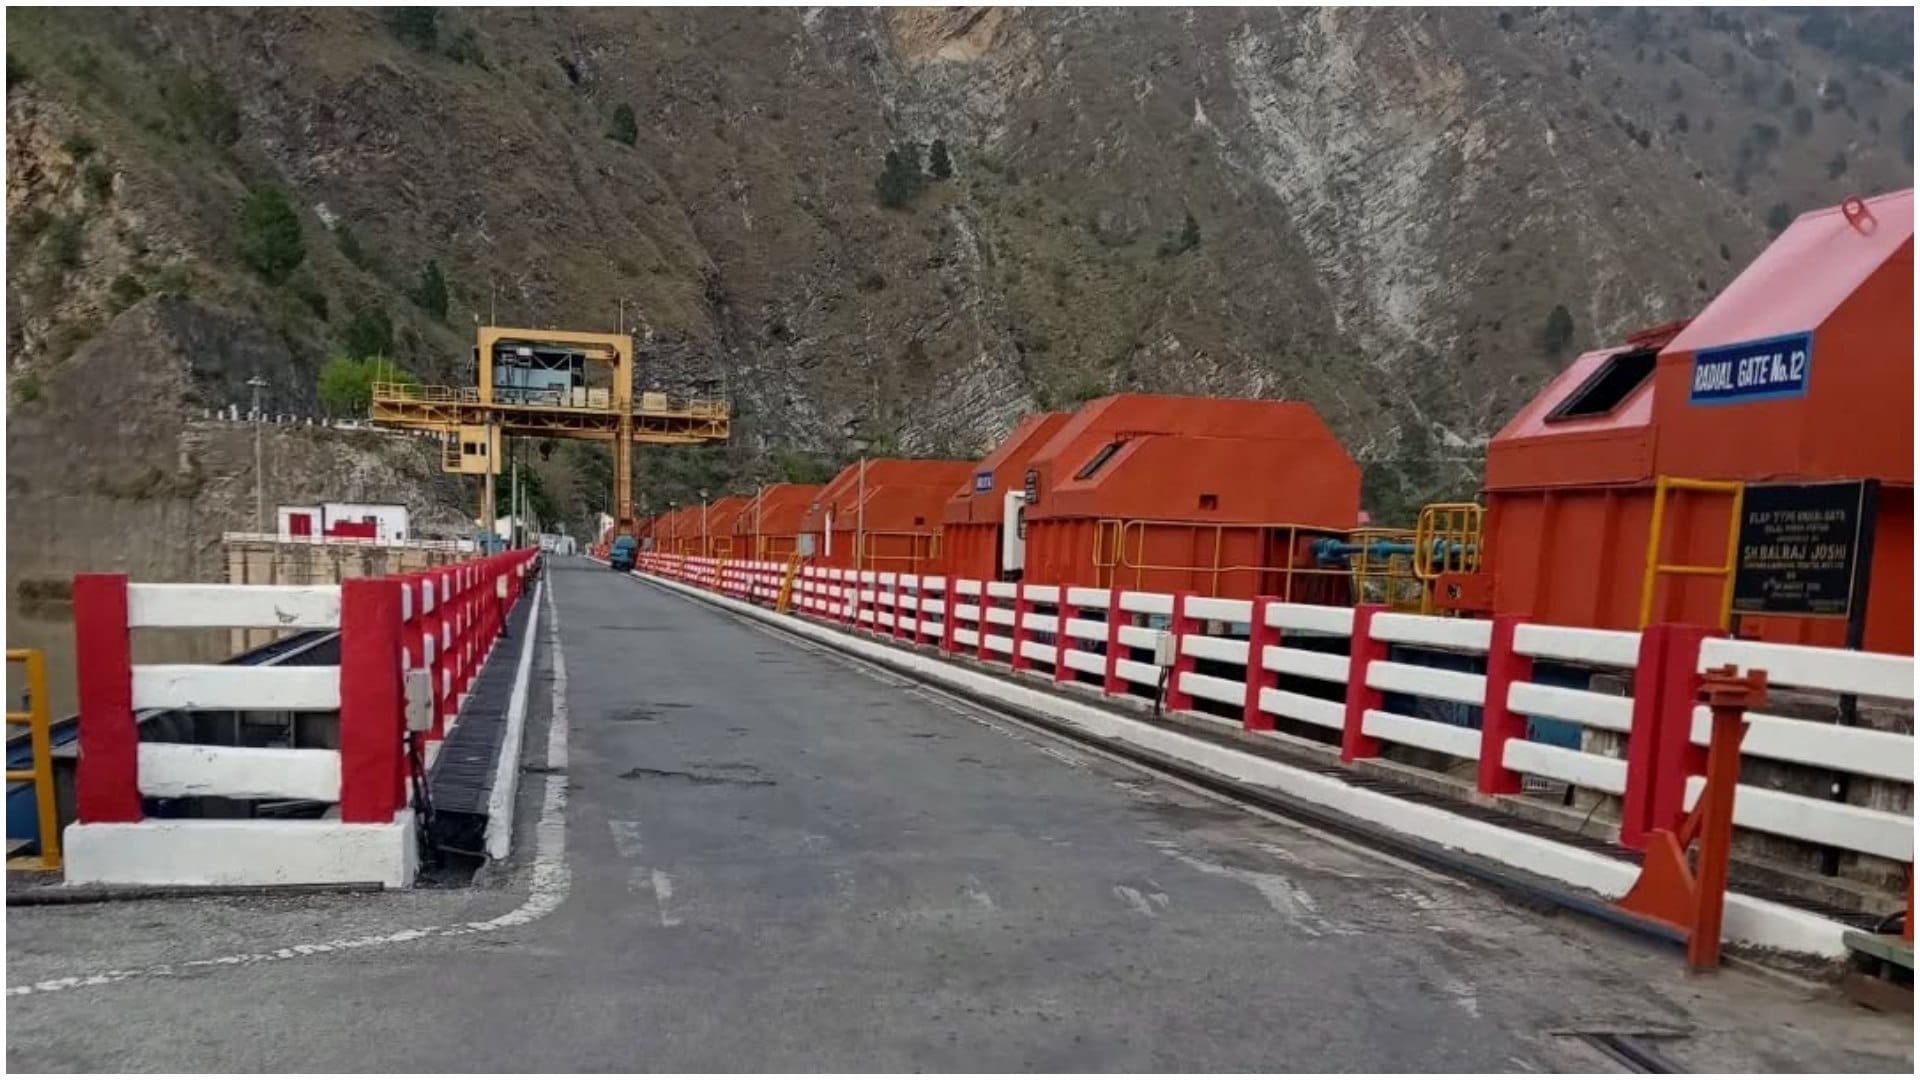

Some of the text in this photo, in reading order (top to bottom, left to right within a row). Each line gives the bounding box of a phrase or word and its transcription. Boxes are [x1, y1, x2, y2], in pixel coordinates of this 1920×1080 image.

[1693, 350, 1806, 392] RADIAL GATE No. 12
[1811, 543, 1846, 560] JOSHI
